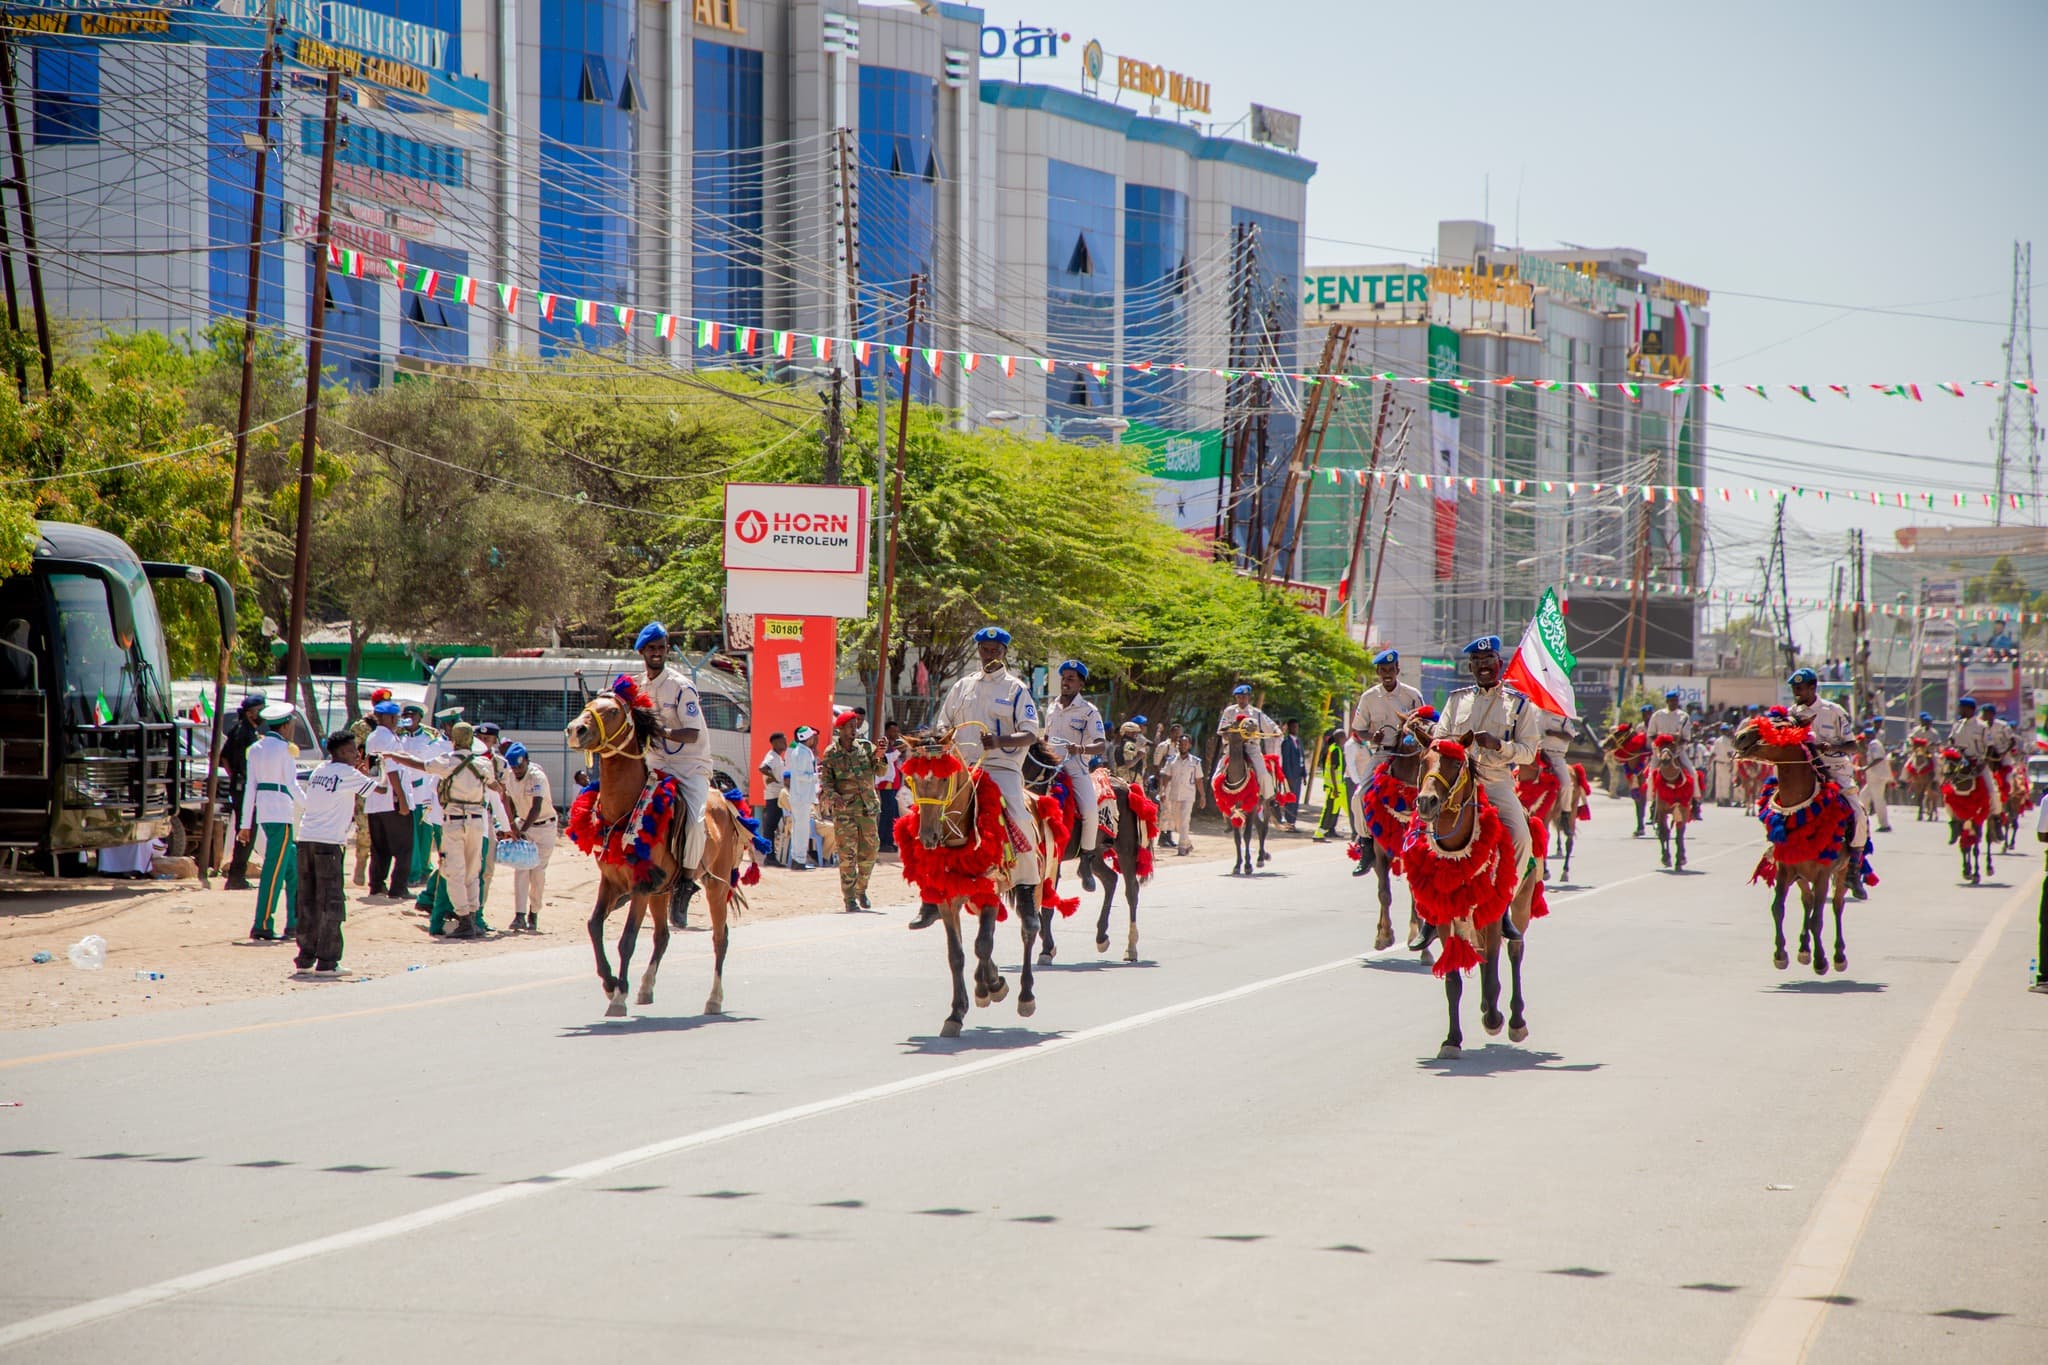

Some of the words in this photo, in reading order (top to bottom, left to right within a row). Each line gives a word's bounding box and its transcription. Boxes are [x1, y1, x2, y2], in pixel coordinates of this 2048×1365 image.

[81, 9, 171, 35] CAMPUS
[330, 1, 450, 70] UNIVERSITY
[297, 37, 362, 77] HADRAWI
[366, 55, 430, 96] CAMPUS
[1168, 70, 1212, 114] MALL
[774, 512, 848, 533] HORN
[773, 534, 848, 547] PETROLEUM
[770, 624, 803, 635] 301801
